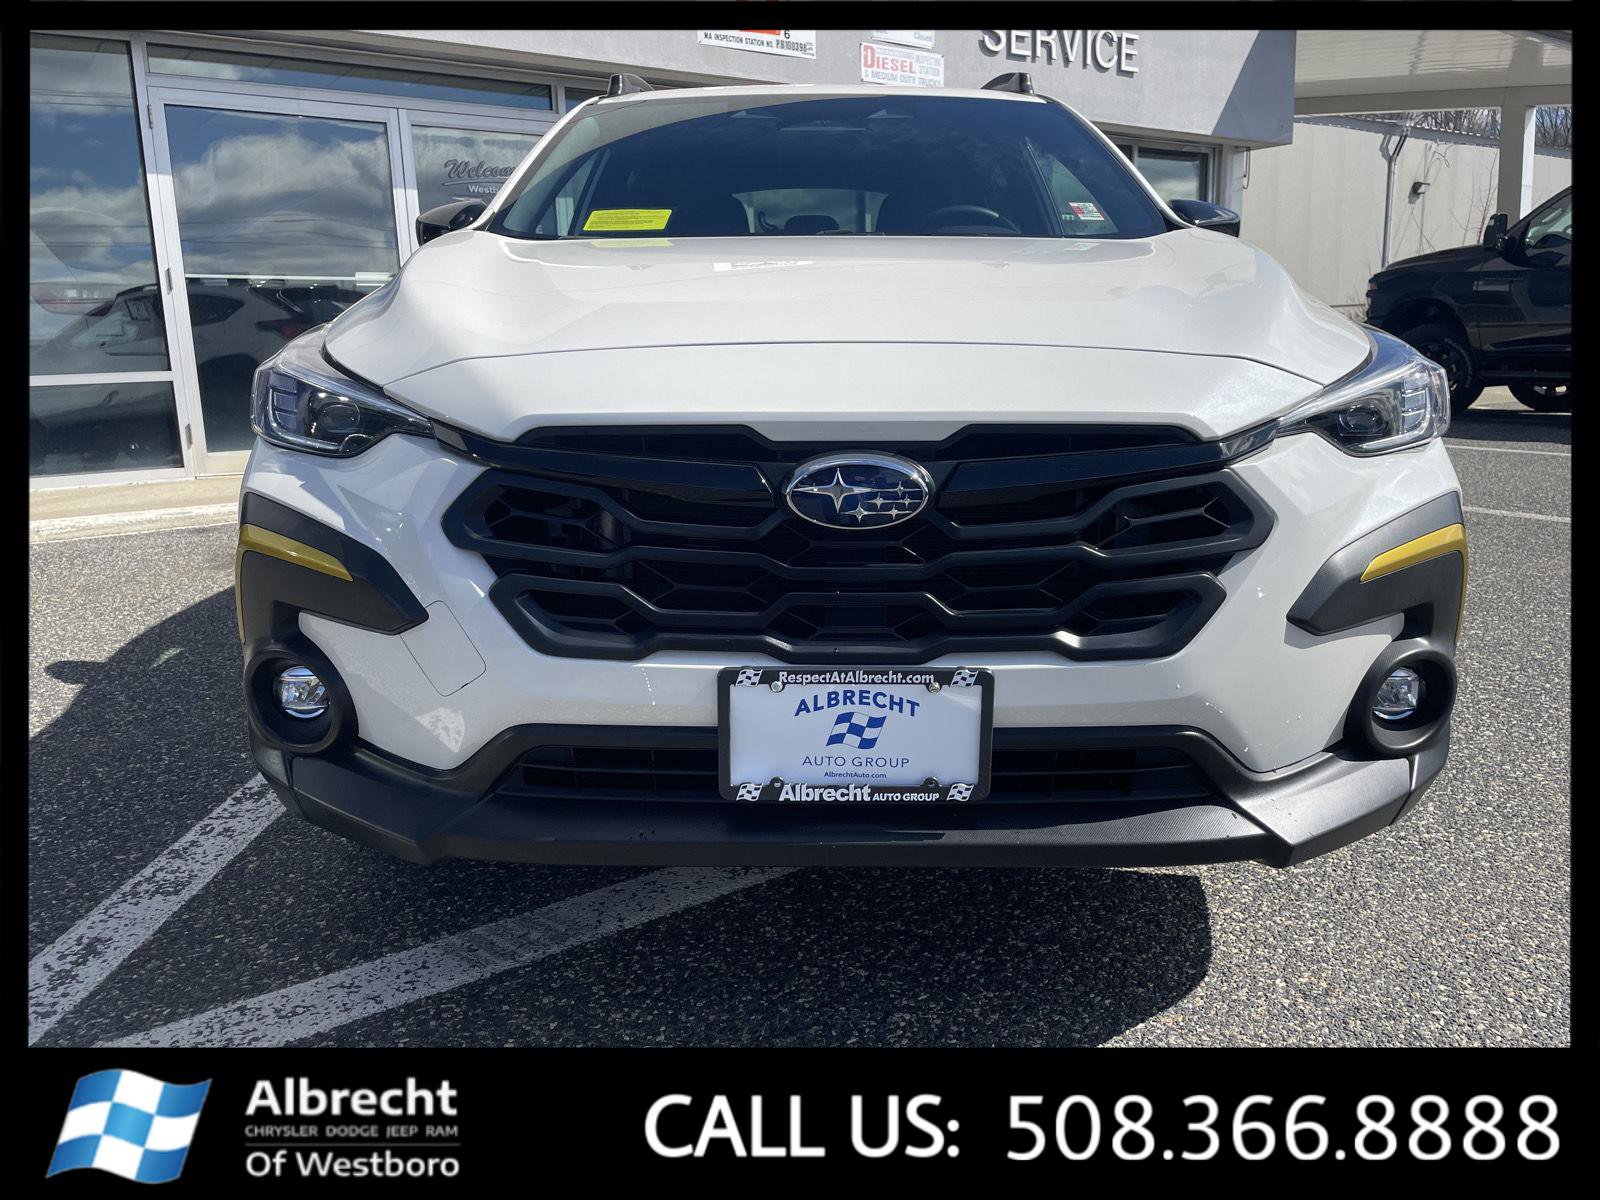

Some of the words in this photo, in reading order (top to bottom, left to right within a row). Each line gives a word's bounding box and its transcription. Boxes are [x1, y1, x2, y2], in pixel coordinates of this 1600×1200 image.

[704, 32, 713, 40] MA
[714, 34, 744, 44] INSPECTION
[745, 39, 765, 47] STATION
[863, 44, 917, 74] DIESEL
[982, 30, 1140, 73] SERVICE
[871, 70, 898, 82] MEDIUM
[444, 158, 516, 179] Welcom
[779, 670, 934, 685] RespectAtAlbrecht.com
[794, 689, 920, 717] ALBRECHT
[802, 755, 846, 767] AUTO
[852, 756, 909, 769] GROUP
[823, 771, 887, 779] AlbrechtAuto.com
[778, 785, 871, 802] Albrecht
[873, 792, 902, 801] AUTO
[902, 792, 940, 802] GROUP
